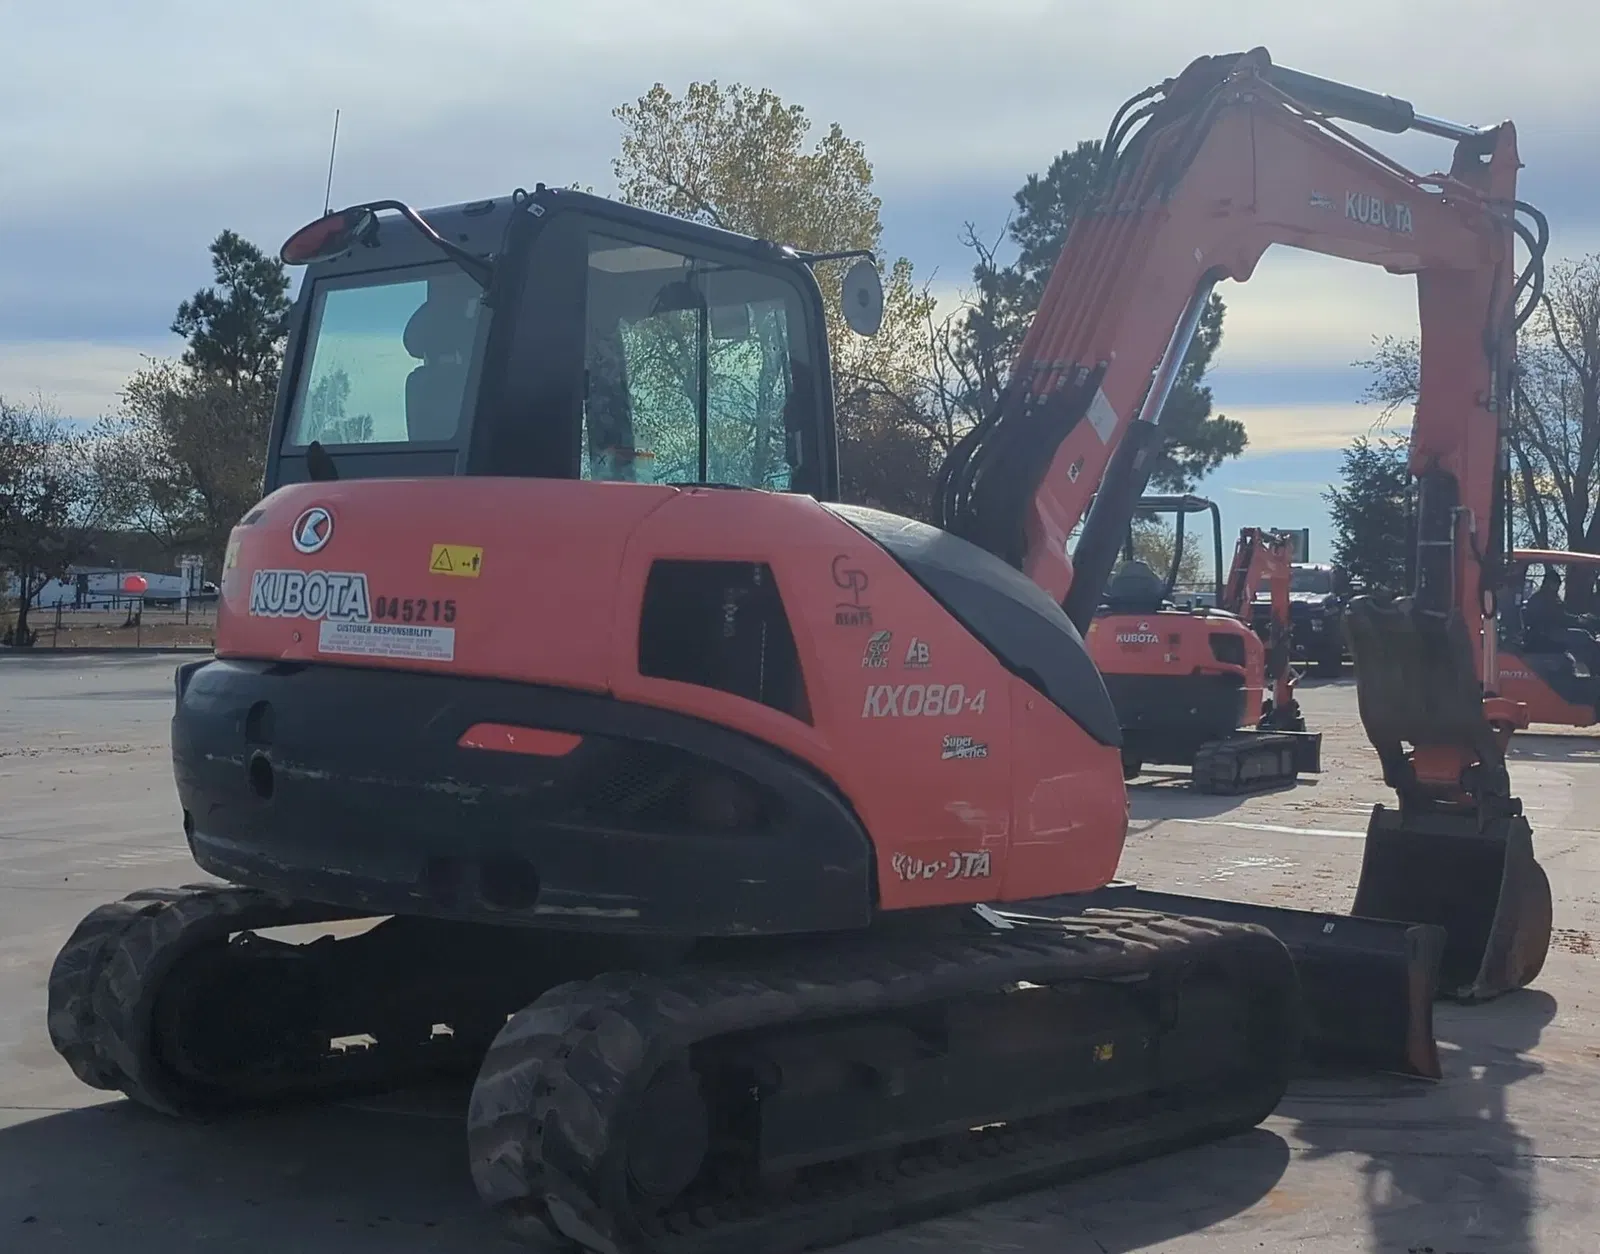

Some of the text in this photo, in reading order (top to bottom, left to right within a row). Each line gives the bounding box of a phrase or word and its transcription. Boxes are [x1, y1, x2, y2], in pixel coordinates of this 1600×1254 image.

[251, 571, 369, 618] KUBOTA
[376, 596, 456, 623] 045215
[336, 624, 433, 637] CUSTOMER RESPONSIBILITY
[1116, 633, 1159, 644] KUBOTA
[862, 657, 889, 668] PLUS
[862, 684, 986, 718] KX080-4
[942, 735, 972, 747] Super
